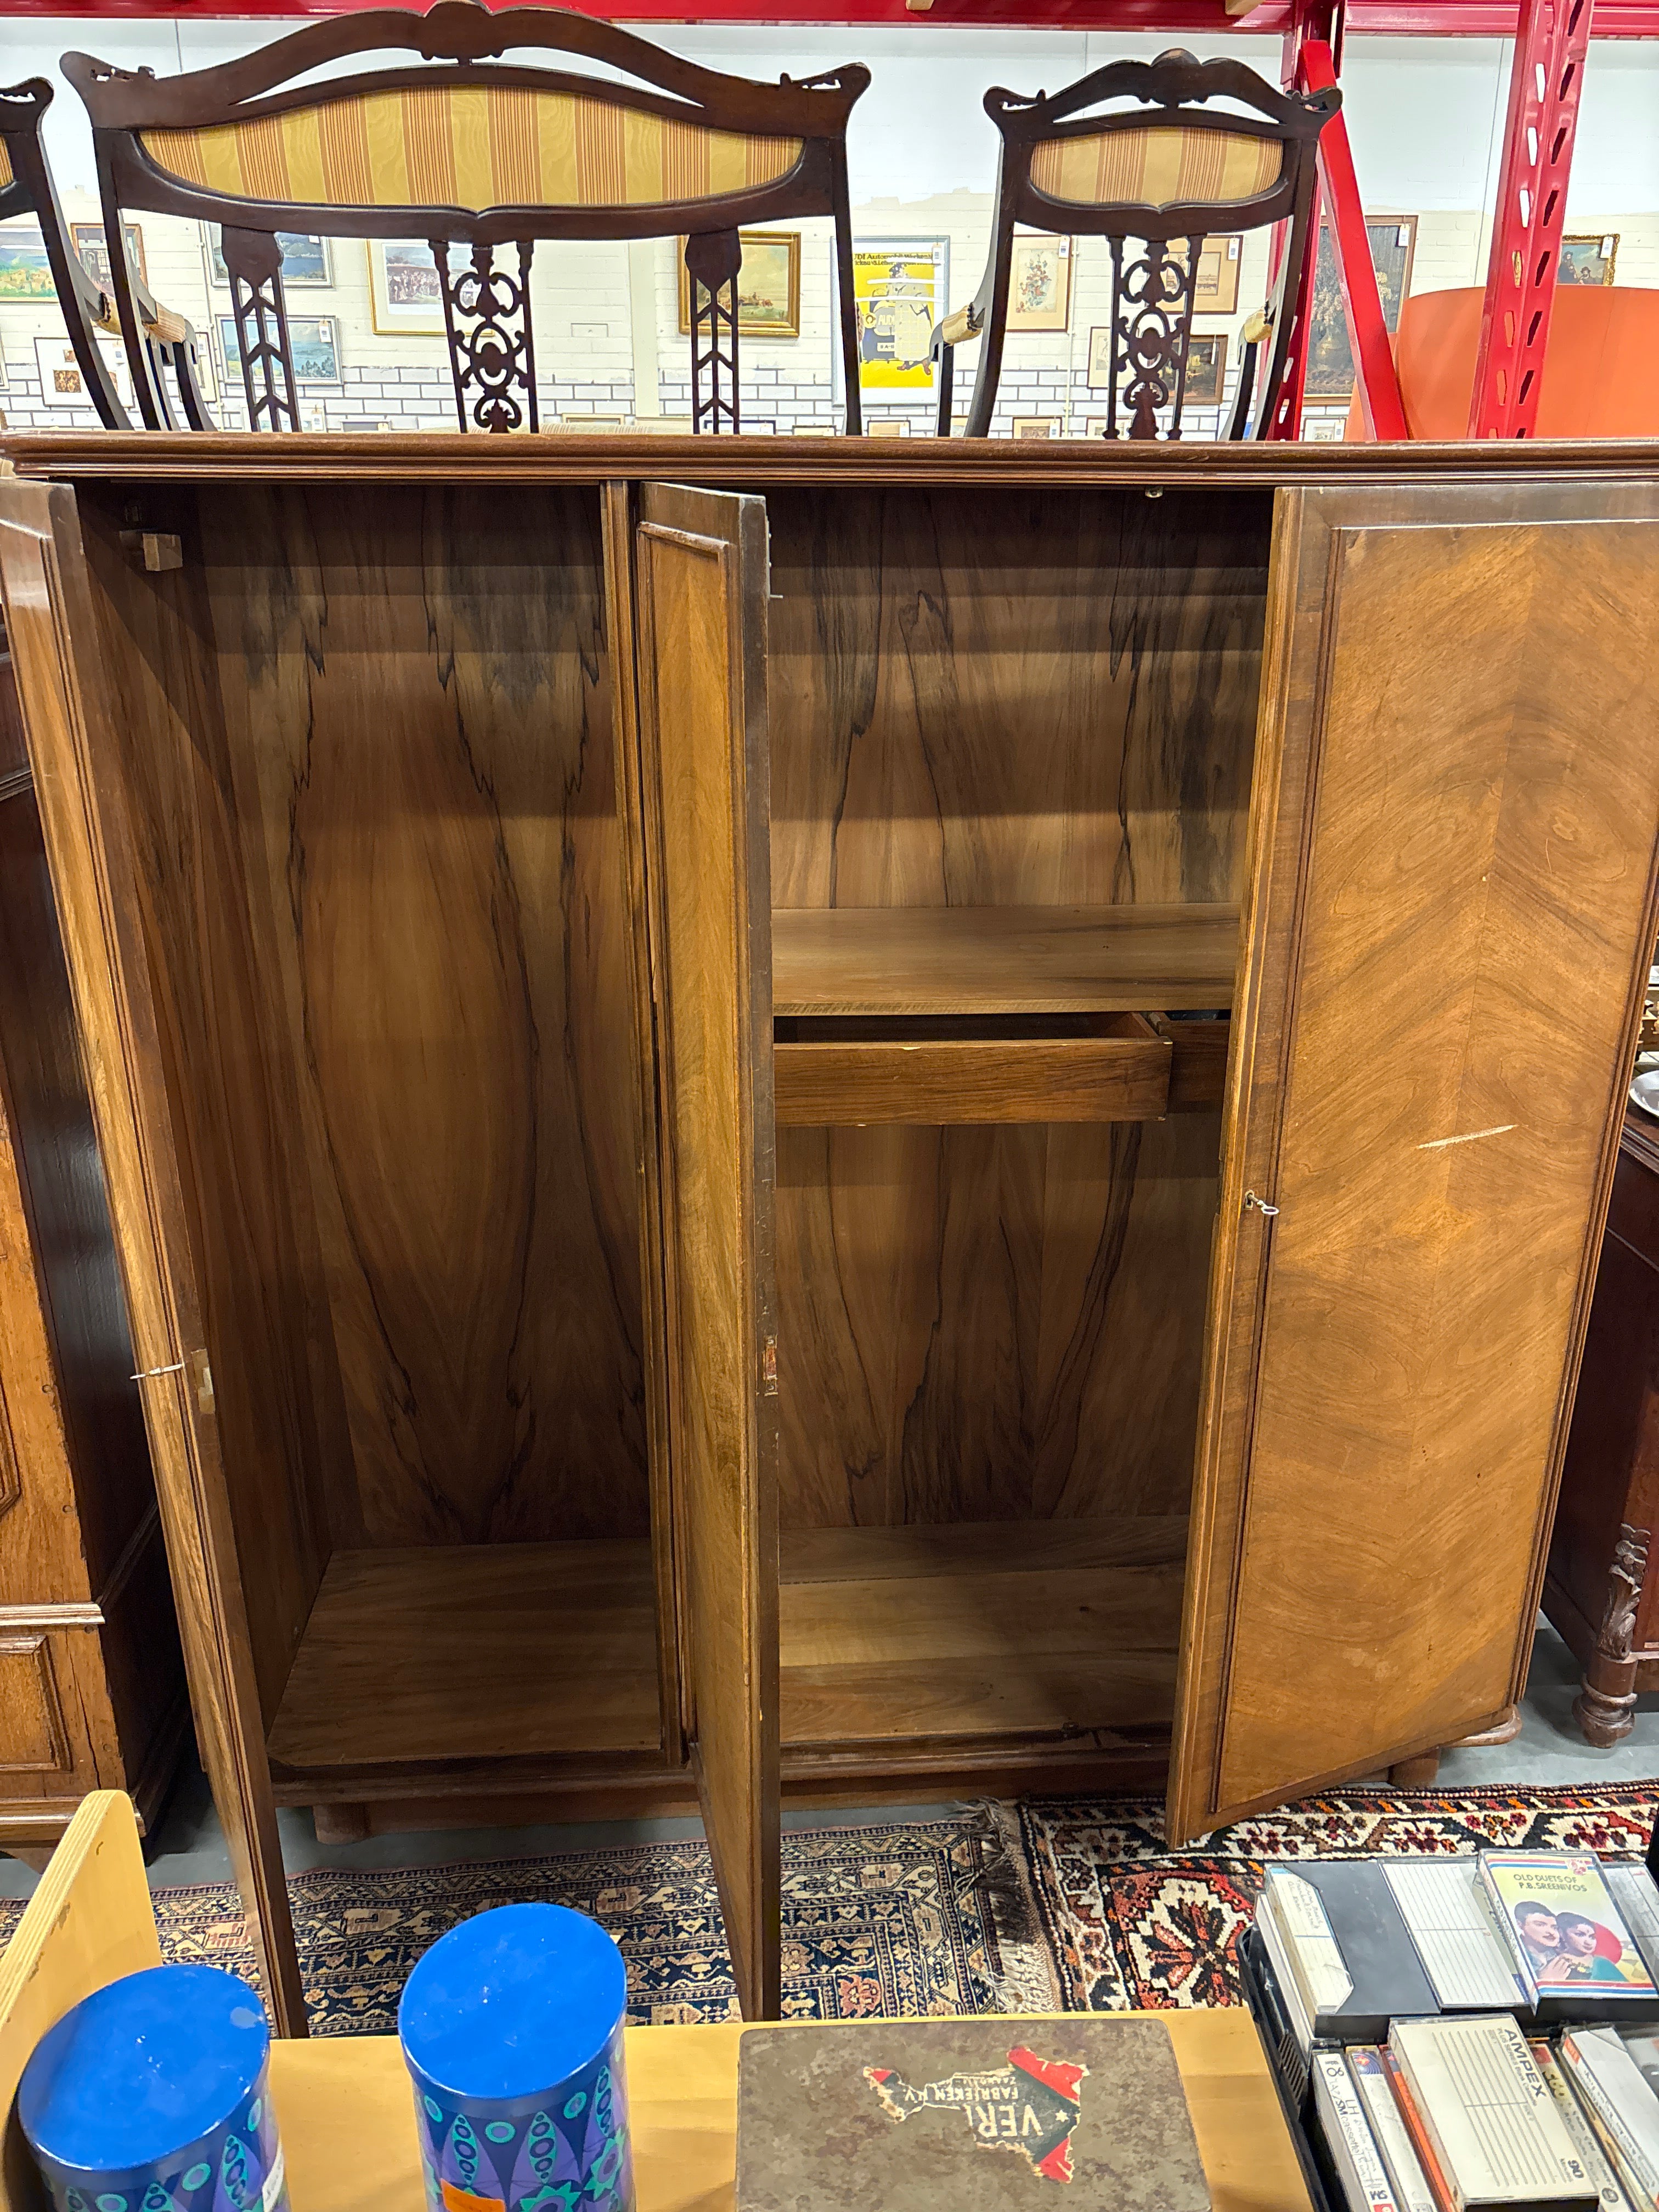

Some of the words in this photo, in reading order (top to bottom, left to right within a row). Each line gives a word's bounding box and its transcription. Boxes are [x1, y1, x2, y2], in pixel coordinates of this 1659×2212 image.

[1536, 1875, 1564, 1883] DUETS
[1564, 1875, 1577, 1883] OF
[1504, 2029, 1547, 2097] AMPEX
[935, 2086, 1019, 2102] FABRIEKEN
[1345, 2100, 1360, 2115] LH
[1567, 2159, 1584, 2179] 90
